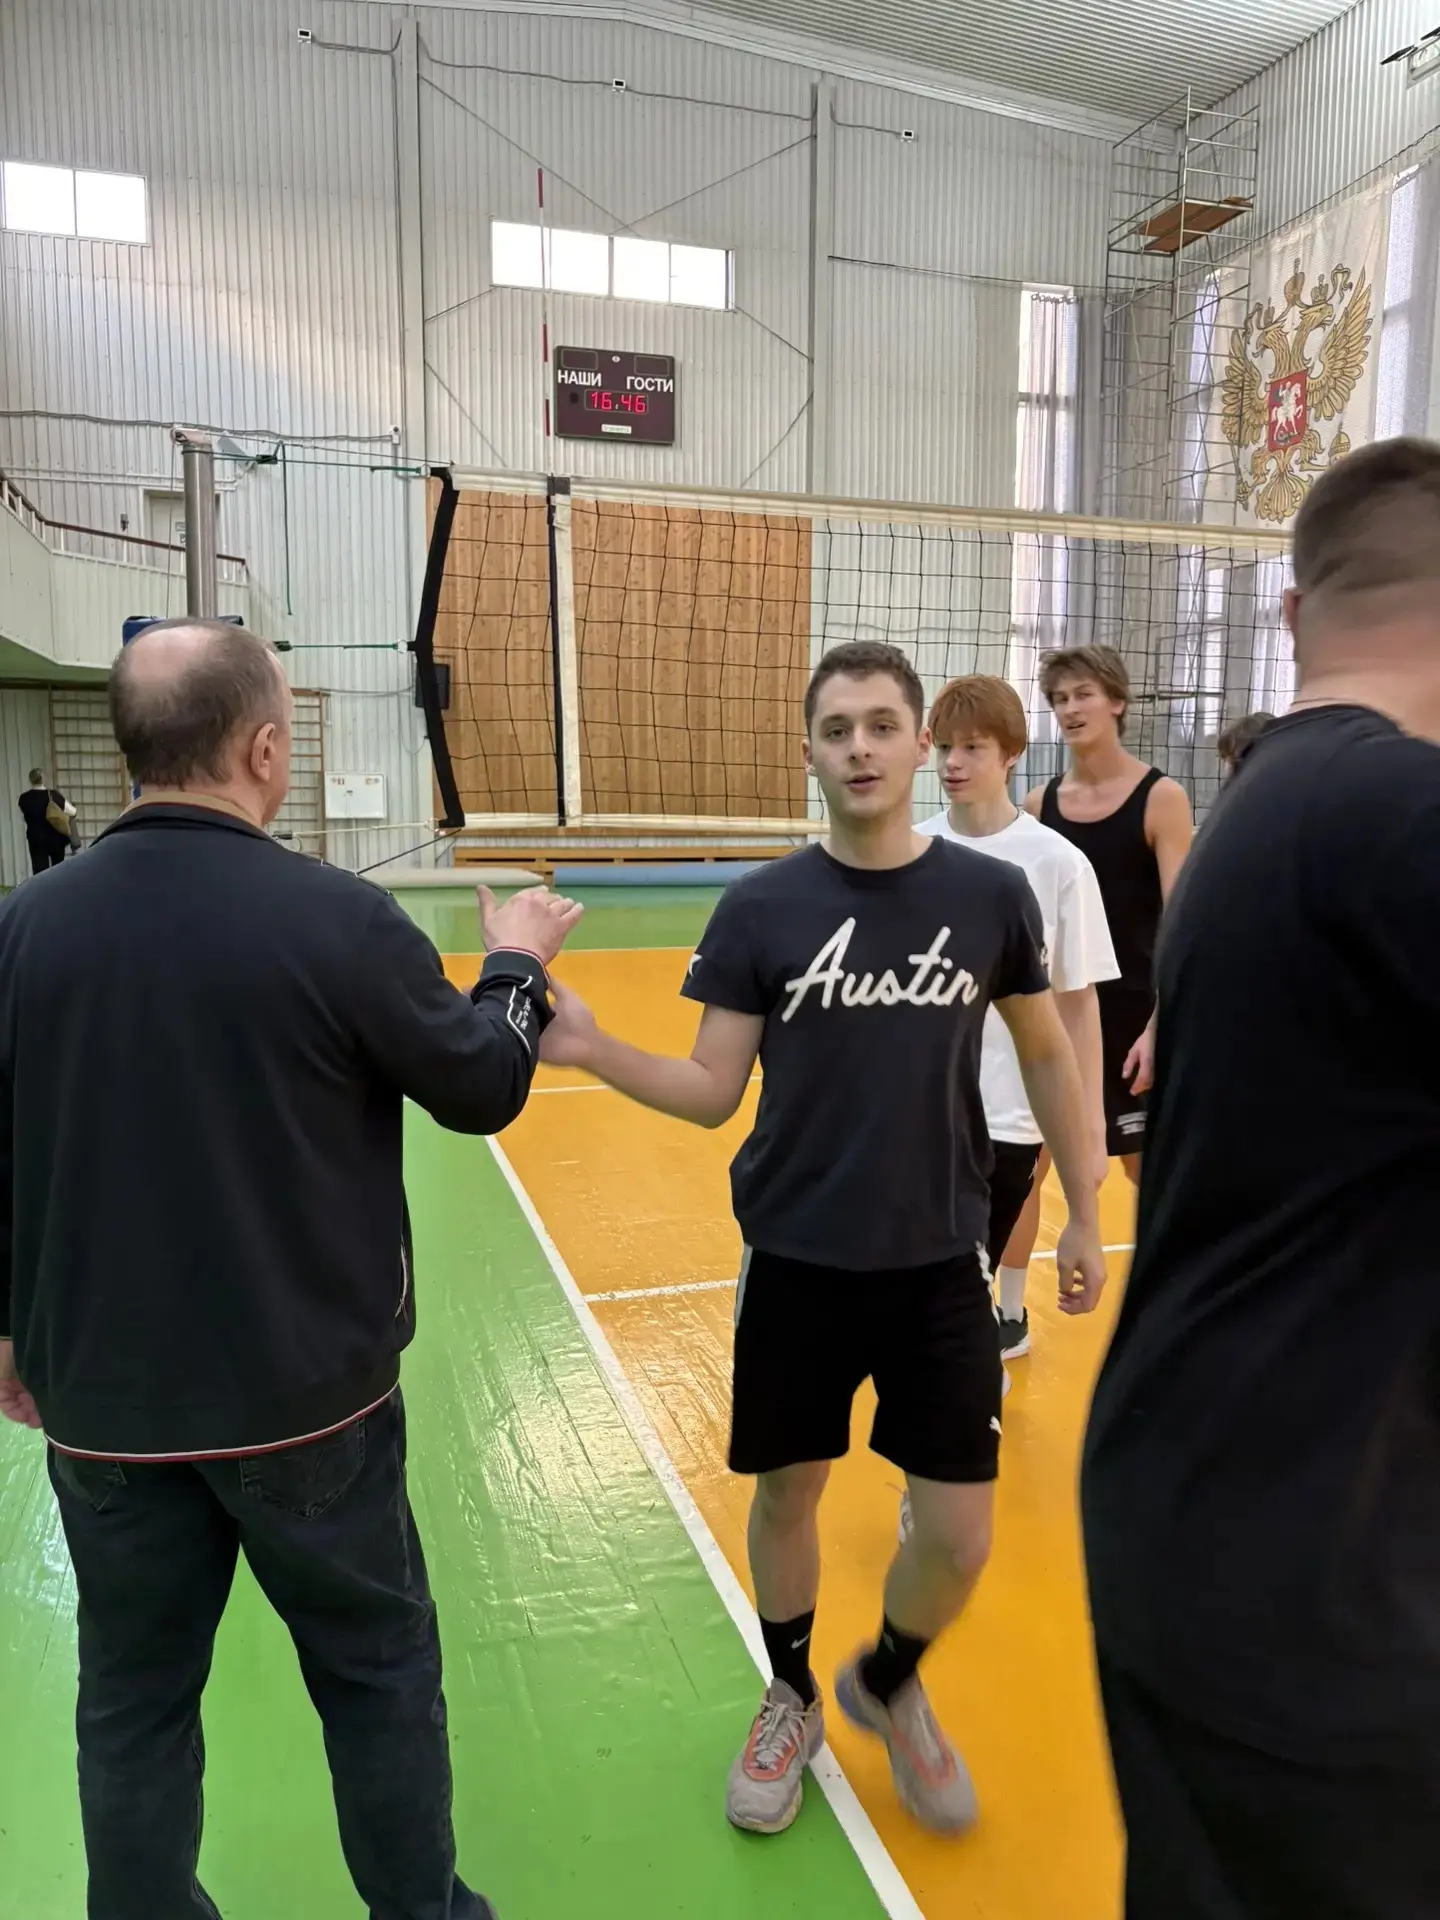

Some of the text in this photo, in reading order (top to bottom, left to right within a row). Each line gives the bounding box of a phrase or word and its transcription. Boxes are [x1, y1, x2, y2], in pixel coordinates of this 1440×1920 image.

[557, 369, 674, 393] НАШИ ГОСТИ
[781, 917, 979, 1023] Austin
